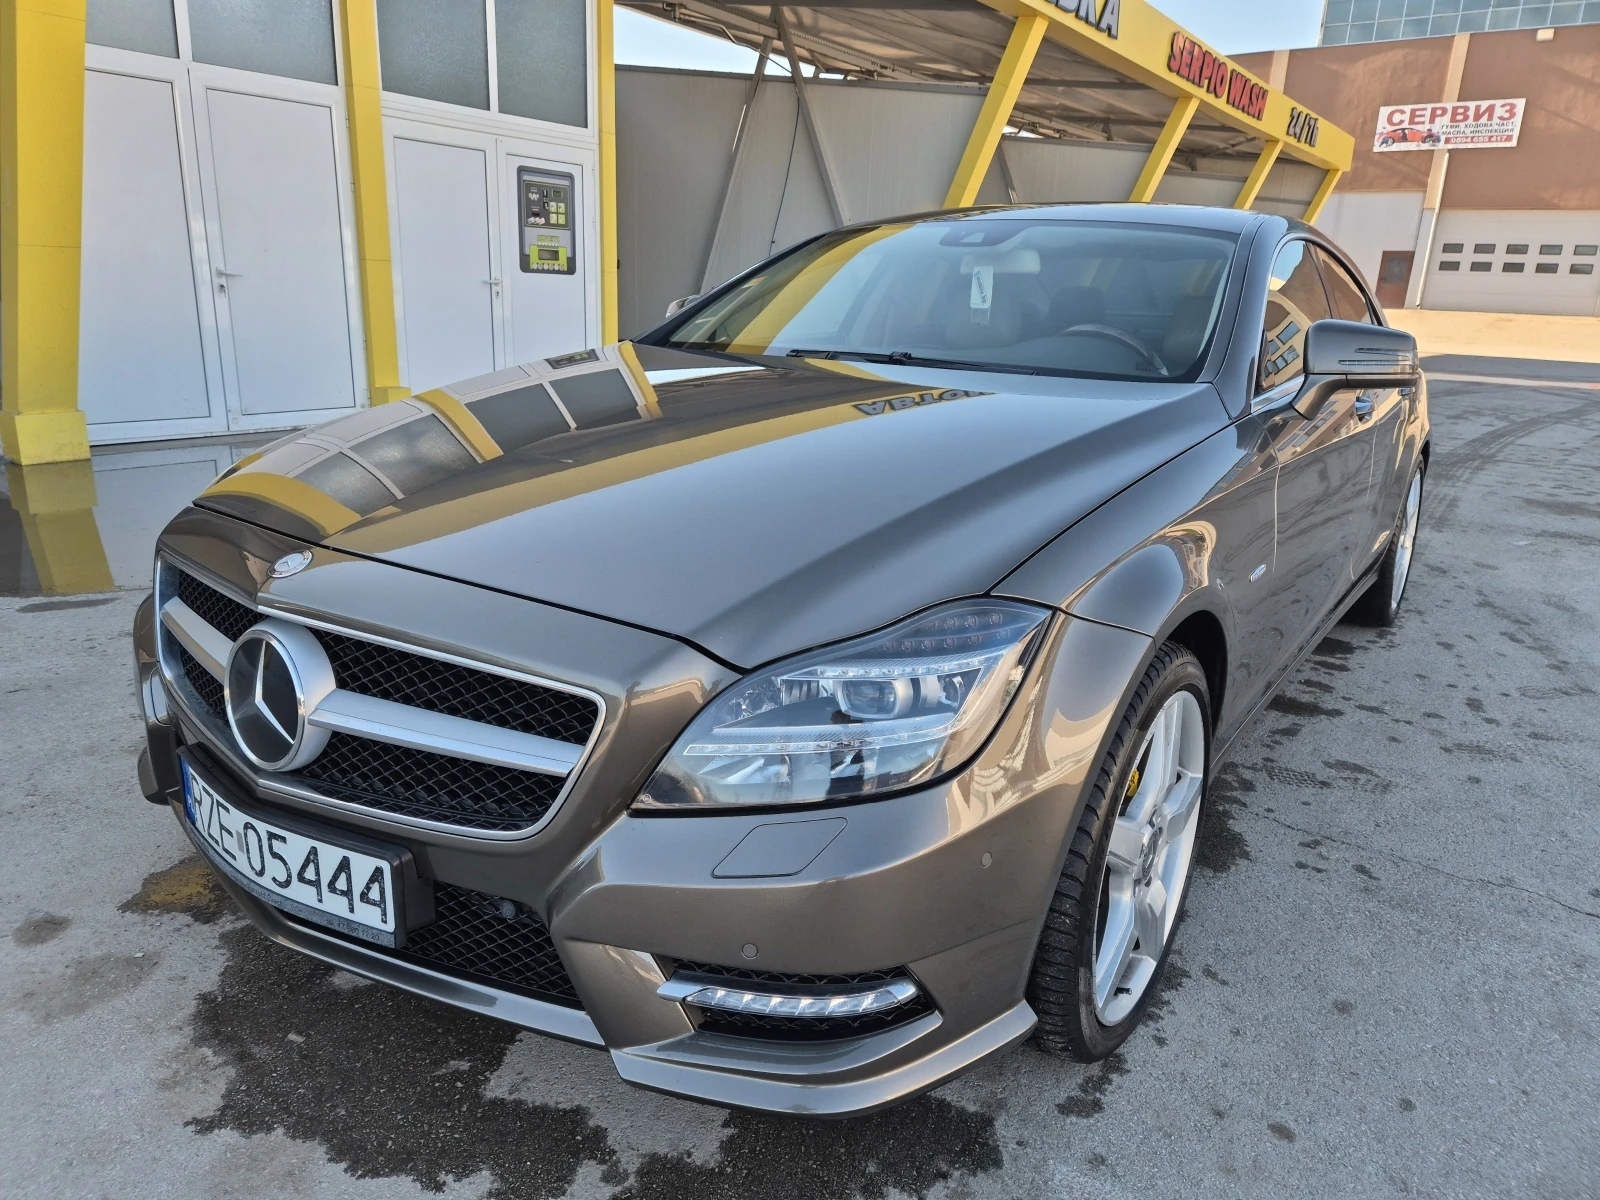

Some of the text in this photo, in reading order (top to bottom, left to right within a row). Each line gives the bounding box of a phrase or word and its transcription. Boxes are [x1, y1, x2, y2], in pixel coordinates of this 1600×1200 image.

[1167, 31, 1269, 121] SERPIO WASH
[1386, 102, 1517, 126] СЕРВИЗ
[189, 770, 388, 925] RZE 05444
